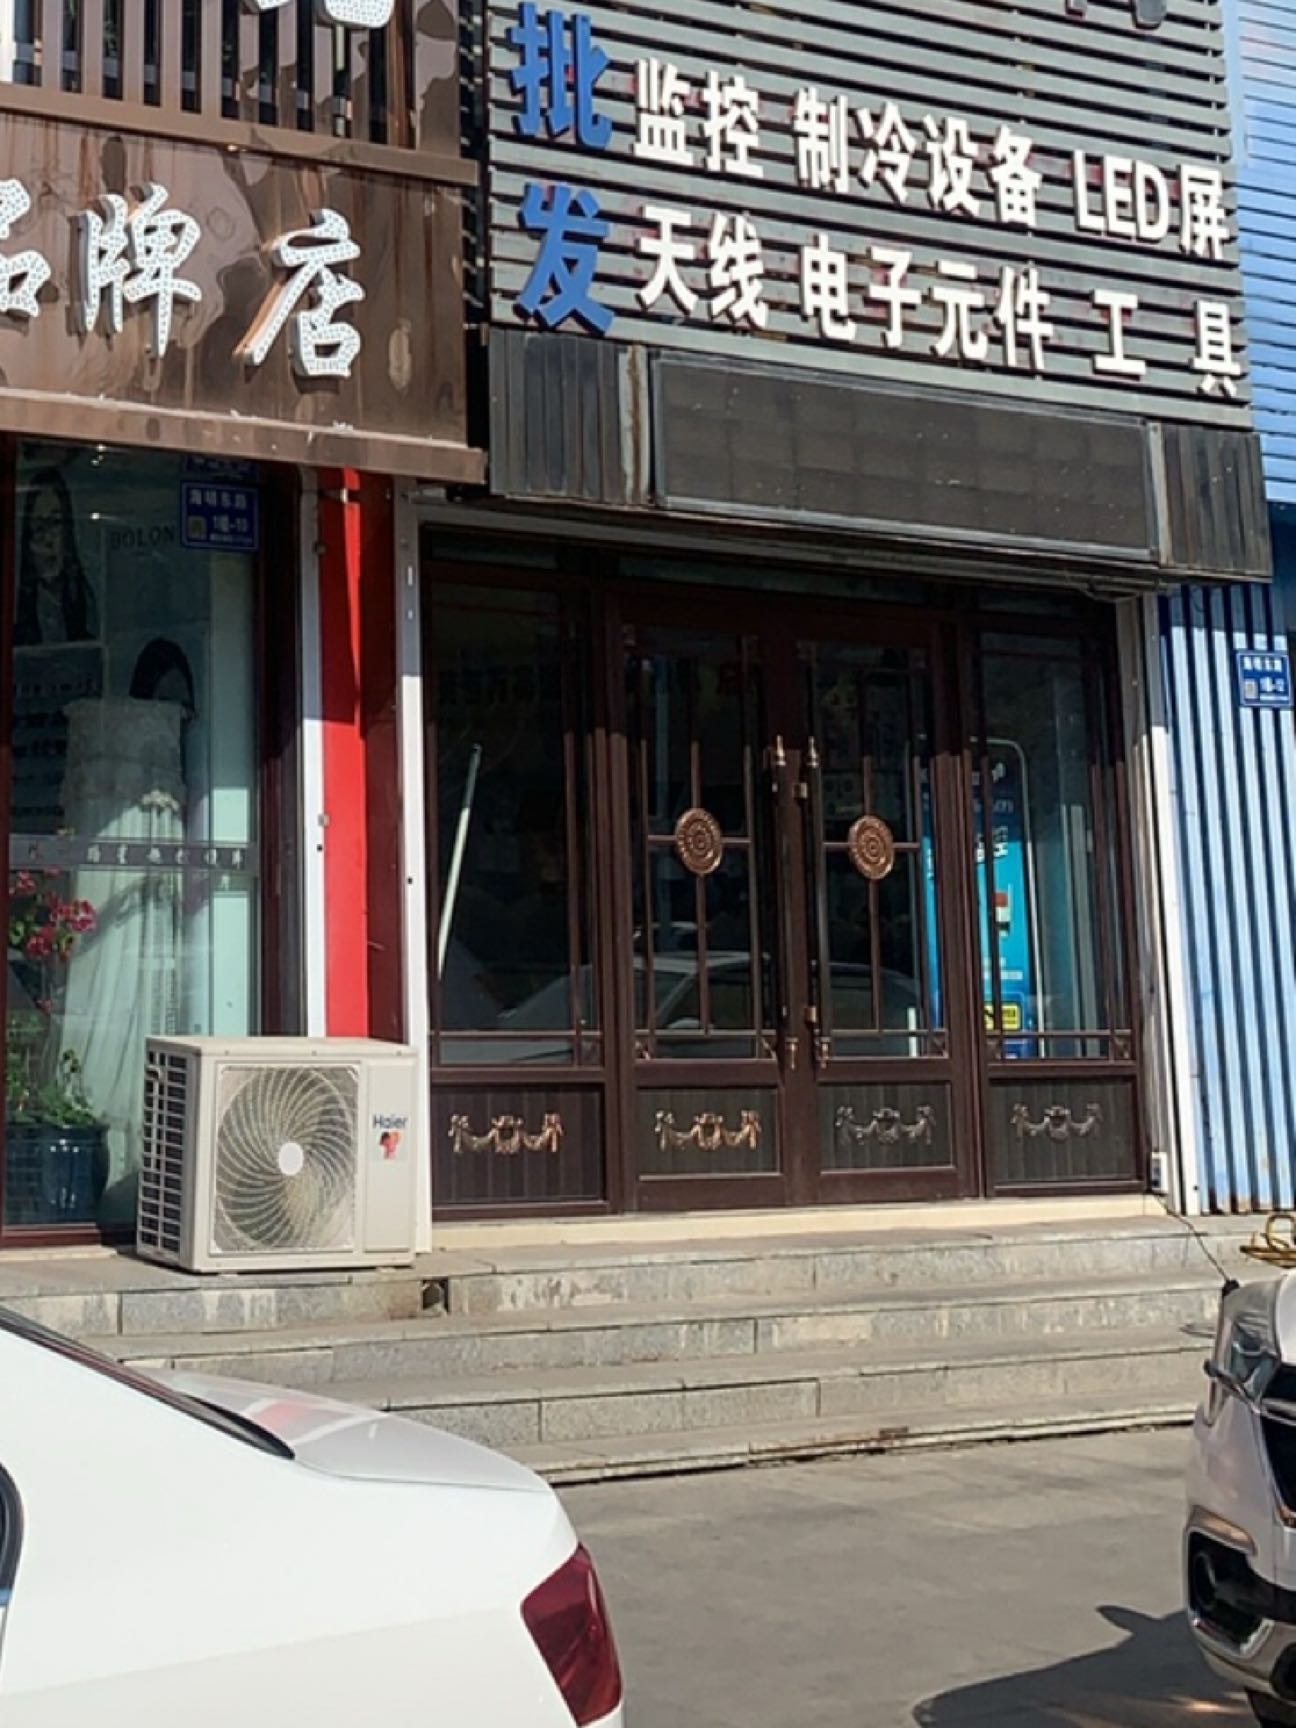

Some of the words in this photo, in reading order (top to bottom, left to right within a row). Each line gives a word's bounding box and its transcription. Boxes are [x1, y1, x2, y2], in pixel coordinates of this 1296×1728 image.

[632, 57, 764, 180] 监控
[793, 86, 1043, 228] 制冷设备
[1071, 149, 1233, 262] LED屏
[636, 204, 770, 331] 天线
[799, 234, 1056, 371] 电子元件
